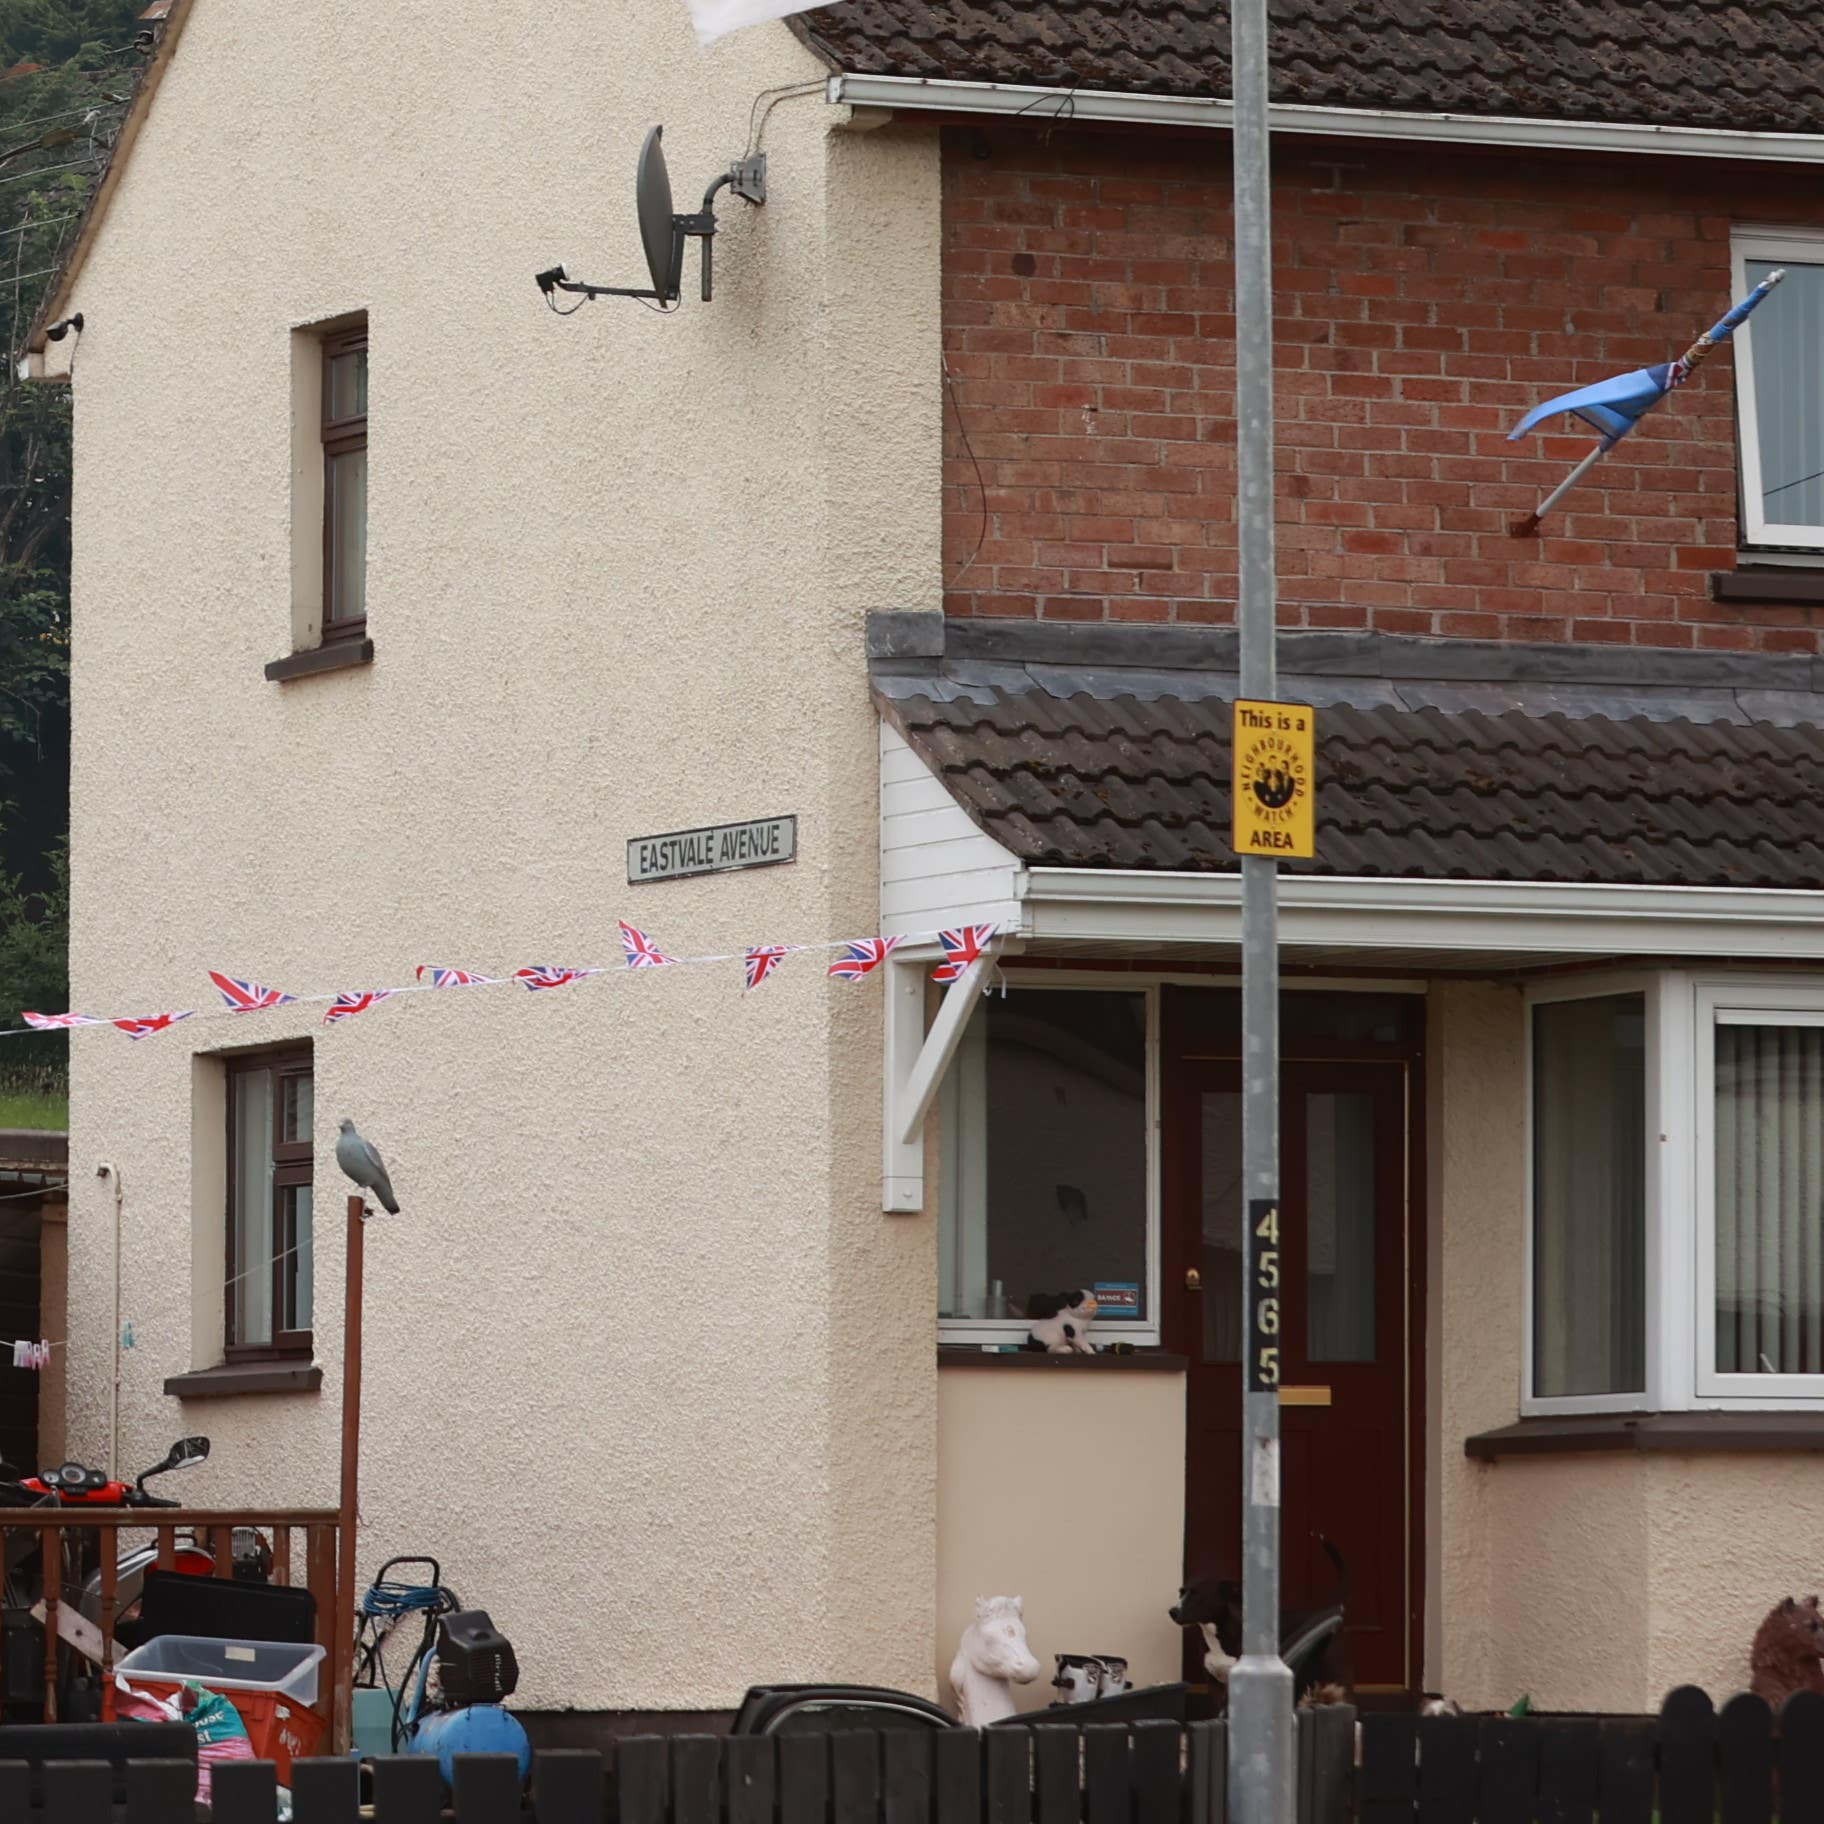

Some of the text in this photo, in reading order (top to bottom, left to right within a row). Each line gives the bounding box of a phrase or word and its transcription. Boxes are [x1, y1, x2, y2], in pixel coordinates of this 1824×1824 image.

[1240, 709, 1305, 731] This is a
[1241, 736, 1306, 797] NEIGHBOURHOOD
[1253, 806, 1294, 824] WATCH
[640, 824, 780, 874] EASTVALE AVENUE
[1250, 829, 1294, 849] AREA
[1255, 1208, 1280, 1384] 4565
